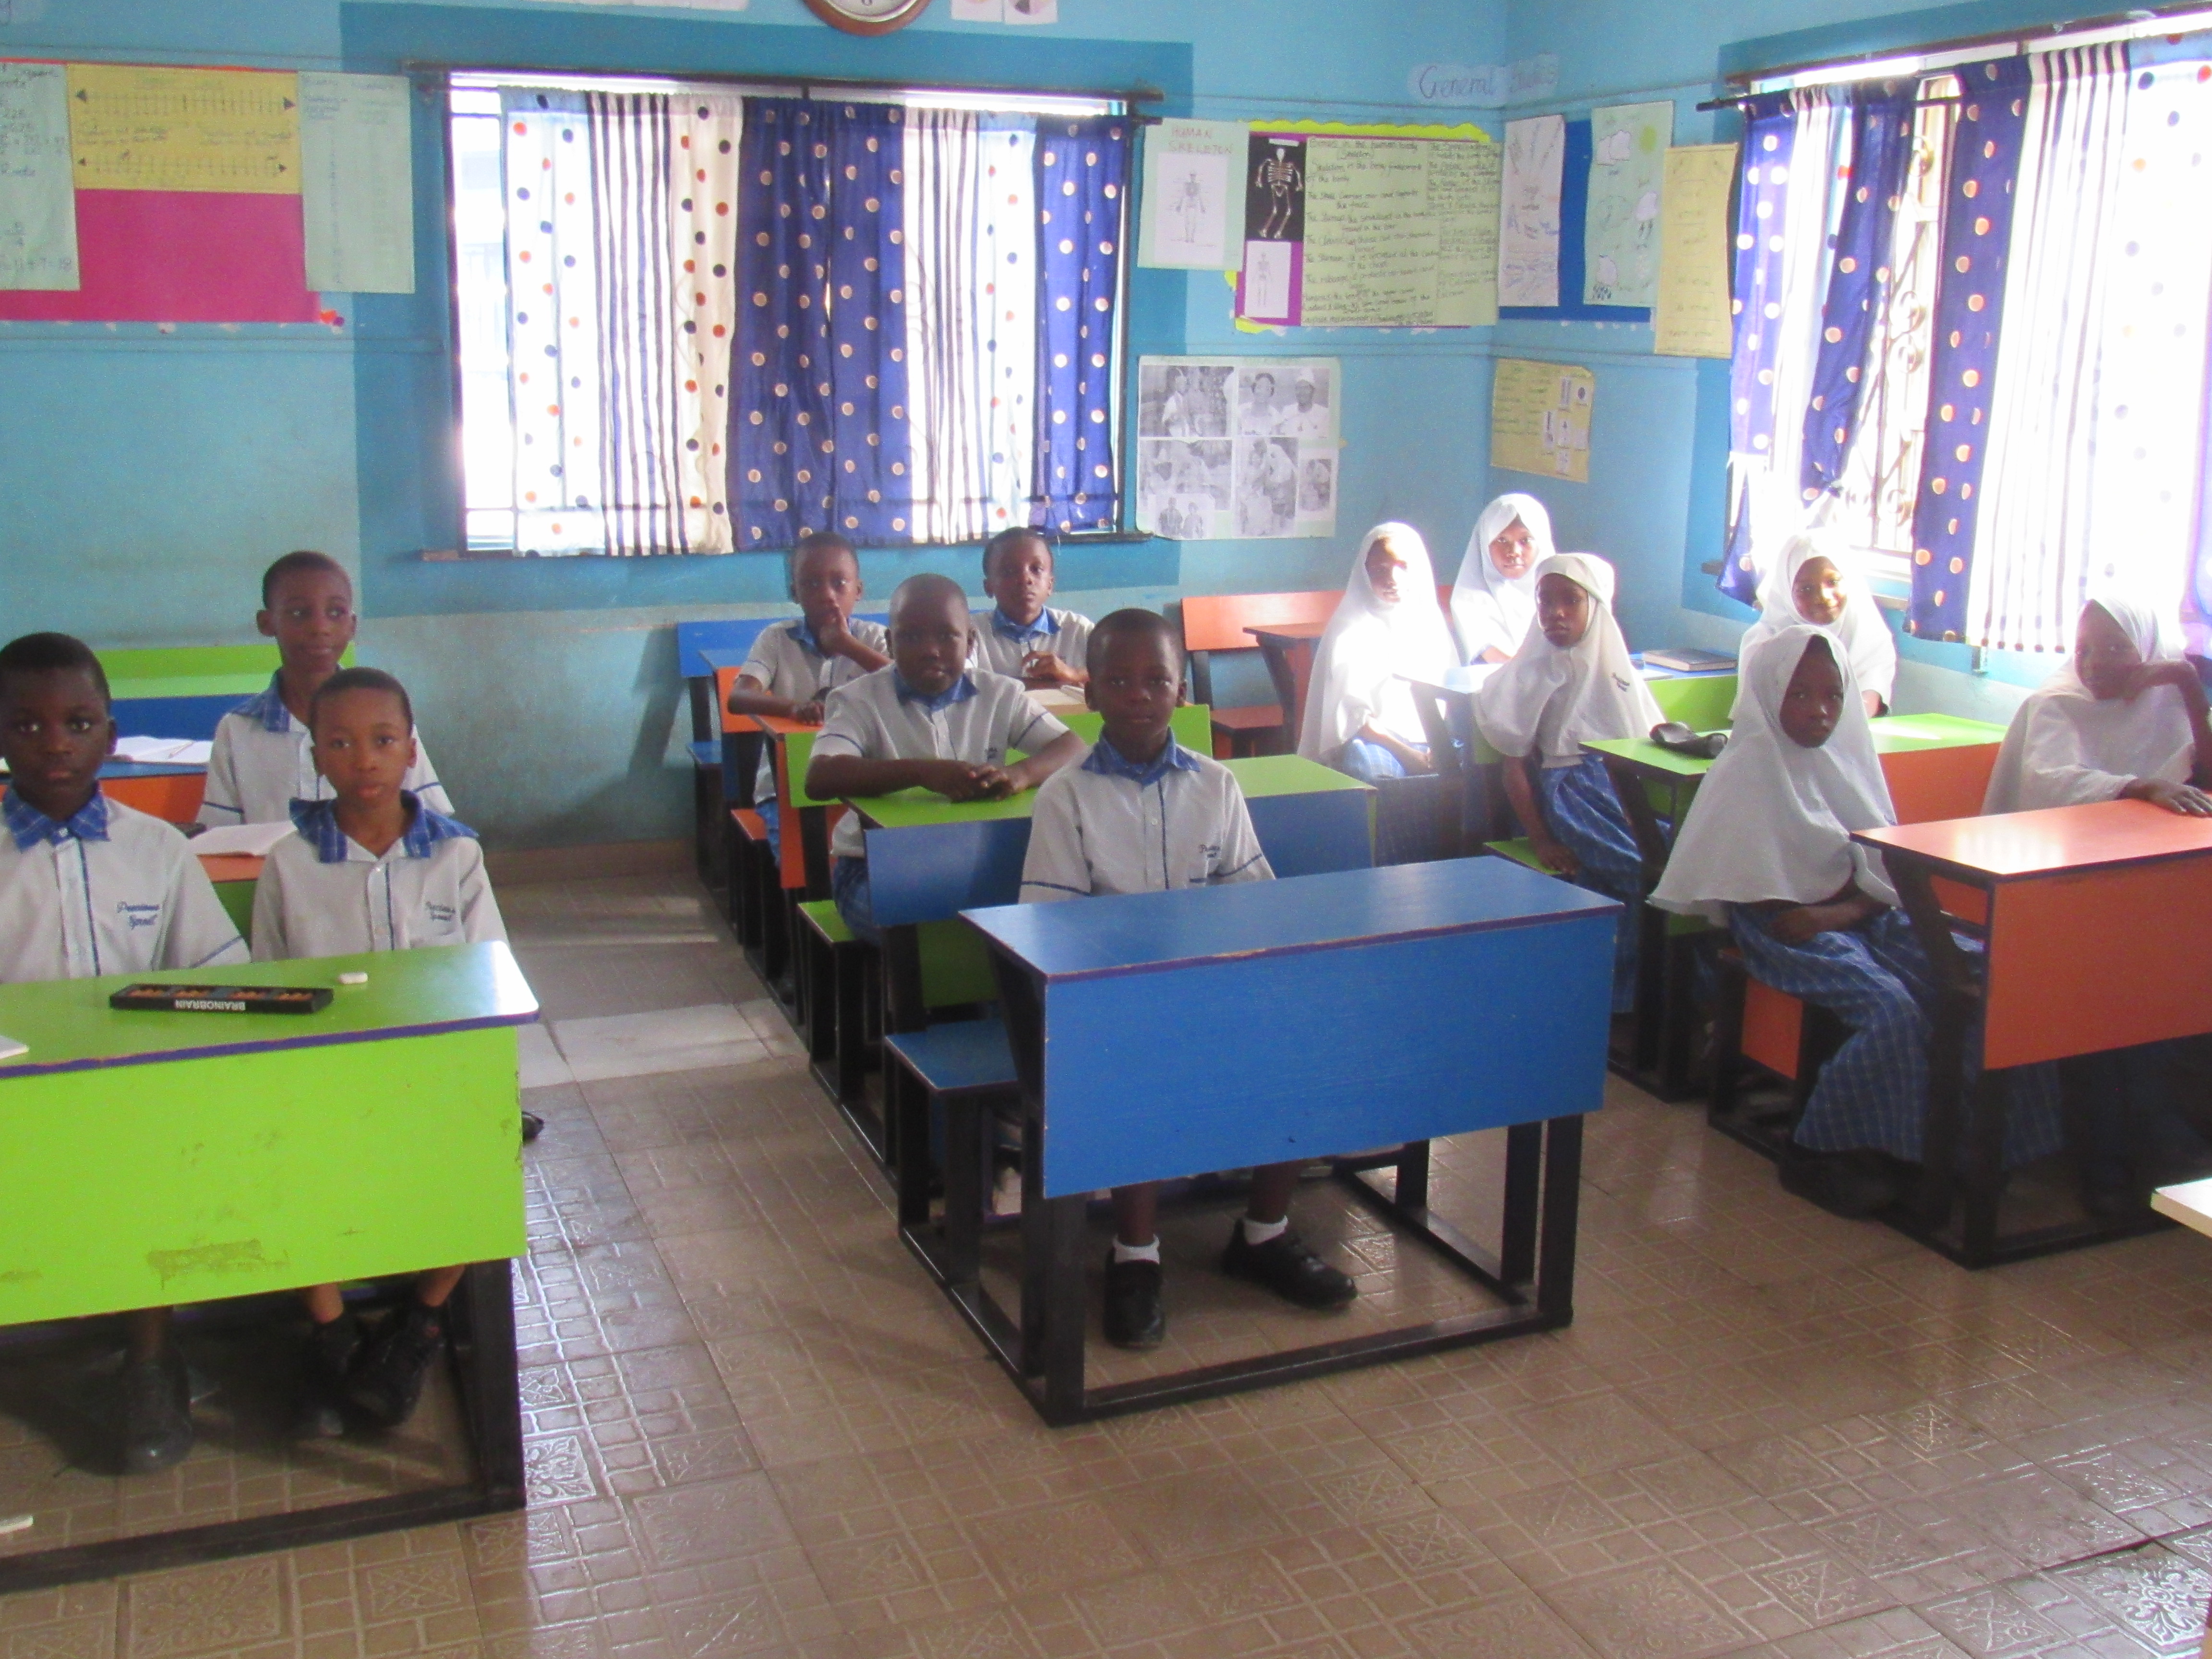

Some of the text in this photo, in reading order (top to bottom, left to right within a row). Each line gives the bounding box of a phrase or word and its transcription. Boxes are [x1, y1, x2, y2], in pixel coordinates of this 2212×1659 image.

[1419, 65, 1494, 99] General
[1171, 126, 1212, 139] HUMAN
[1168, 140, 1234, 155] SKELETON
[175, 999, 246, 1012] BRAINOBRAIN
